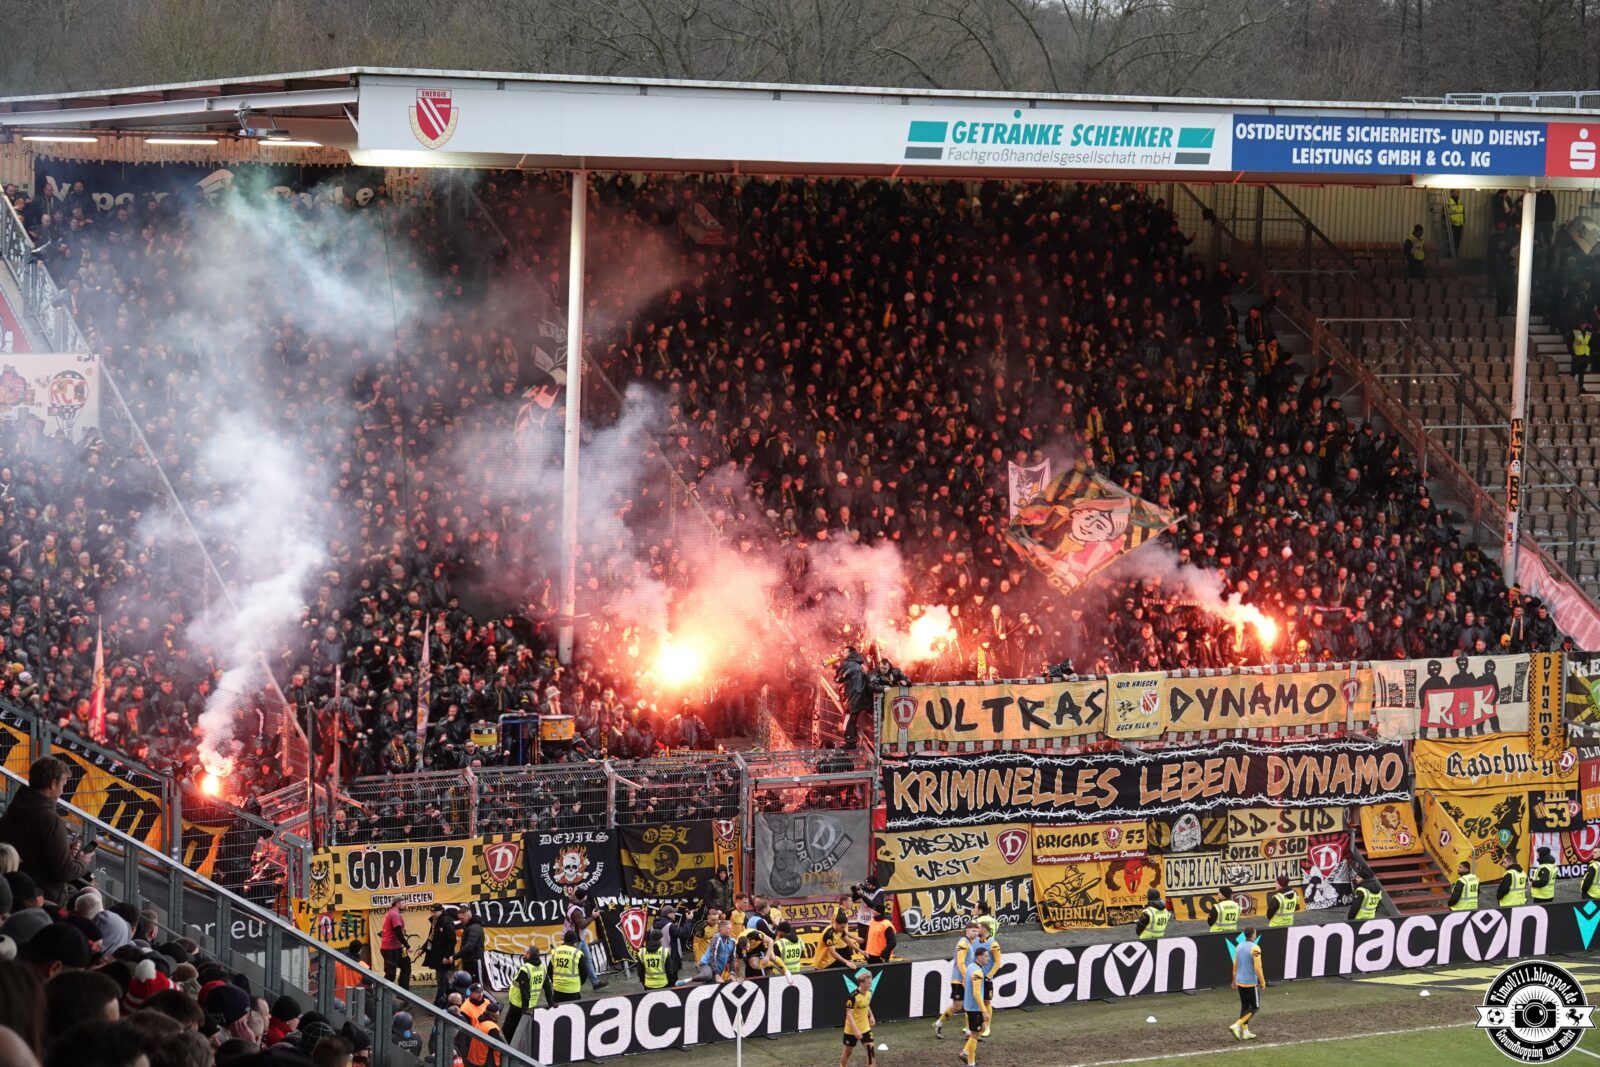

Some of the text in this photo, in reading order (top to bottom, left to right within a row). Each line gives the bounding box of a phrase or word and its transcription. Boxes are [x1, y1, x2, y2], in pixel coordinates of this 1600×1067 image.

[951, 109, 1174, 148] GETRÄNKE SCHENKER
[1235, 123, 1545, 146] OSTDEUTSCHE SICHERHEITS- UND DIENST-
[948, 147, 1171, 166] Fachgroßhandelsgesellschaft mbH
[1292, 148, 1491, 167] LEISTUNGS GMBH & CO. KG
[924, 688, 1105, 733] ULTRAS
[1169, 681, 1337, 723] DYNAMO
[1427, 691, 1454, 726] R
[1473, 687, 1495, 720] K
[893, 766, 1121, 815] KRIMINELLES
[1139, 755, 1250, 805] LEBEN
[1266, 752, 1404, 798] DYNAMO
[1545, 802, 1571, 828] 53
[539, 831, 609, 846] DEVILS
[896, 831, 990, 860] DRESDEN
[1036, 832, 1100, 849] BRIGADE
[1126, 829, 1145, 845] 53
[1221, 845, 1259, 860] Forza
[1279, 837, 1307, 854] SGD
[346, 844, 465, 891] GÖRLITZ
[913, 856, 981, 881] WEST
[1254, 860, 1299, 881] DYNAM
[786, 948, 800, 958] 339
[1285, 905, 1549, 980] macron
[556, 958, 569, 968] 152
[646, 958, 660, 968] 137
[533, 973, 814, 1066] macron
